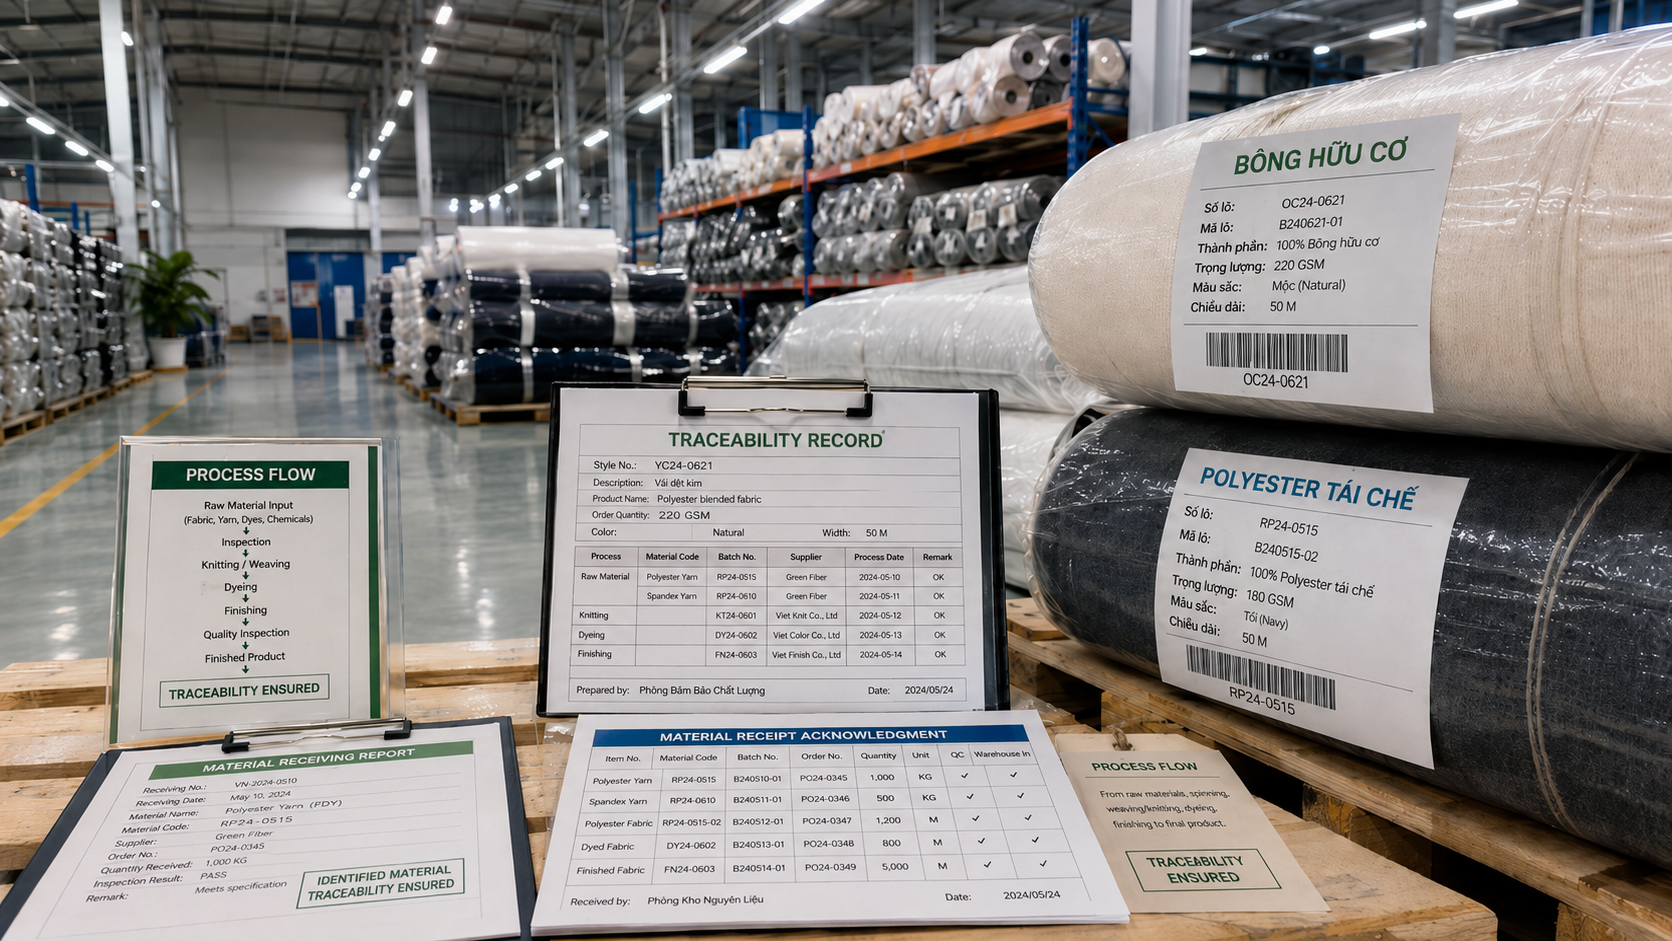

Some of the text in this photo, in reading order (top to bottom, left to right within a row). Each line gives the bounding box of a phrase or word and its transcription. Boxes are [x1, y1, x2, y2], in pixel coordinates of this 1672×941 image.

[1234, 136, 1409, 175] BÔNG HỮU CƠ
[1282, 195, 1344, 209] OC24-0621
[1279, 216, 1342, 230] B240621-01
[1277, 239, 1305, 250] 100%
[1195, 259, 1325, 275] Trọng 220 GSM
[1298, 279, 1346, 293] (Natural)
[1270, 301, 1296, 312] 50 M
[1243, 373, 1308, 389] OC24-0621
[668, 432, 882, 448] TRACEABILITY RECORD
[594, 460, 712, 471] Style No.: YC24-0621
[187, 468, 316, 481] PROCESS FLOW
[593, 478, 643, 488] Description:
[1200, 467, 1419, 511] POLYESTER TÁI CHẾ
[592, 494, 761, 505] Product Name: Polyester blended fabric
[204, 501, 293, 511] Raw Material Input
[184, 515, 313, 526] (Fabric, Dyes, Chemicals)
[592, 511, 710, 520] Order Quantity: 220 GSM
[1184, 506, 1319, 536] Số RP24-0515
[591, 527, 617, 536] Color:
[713, 528, 744, 536] Natural
[822, 529, 850, 537] Width:
[866, 529, 877, 537] 50
[222, 537, 271, 548] Inspection
[591, 552, 621, 560] Process
[790, 553, 822, 562] Supplier
[854, 553, 885, 561] Process
[923, 553, 952, 561] Remark
[1255, 541, 1318, 563] B240515-02
[202, 559, 290, 571] Knitting Weaving
[647, 573, 680, 582] Polyester
[786, 573, 808, 581] Green
[1251, 566, 1332, 591] 100% Polyester
[225, 582, 257, 593] Dyeing
[1172, 574, 1294, 608] Trọng 180 GSM
[647, 592, 678, 601] Spandex
[225, 606, 267, 616] Finishing
[579, 611, 608, 621] Knitting
[1259, 614, 1288, 631] (Navy)
[204, 628, 290, 640] Quality Inspection
[579, 631, 605, 640] Dyeing
[860, 631, 902, 639] 2024-05-13
[1242, 632, 1267, 647] 50 M
[205, 652, 285, 663] Finished Product
[578, 650, 612, 659] Finishing
[169, 683, 320, 700] TRACEABILITY ENSURED
[577, 686, 629, 696] Prepared by:
[905, 686, 953, 694] 2024/05/24
[1230, 686, 1295, 715] RP24-0515
[660, 730, 947, 741] MATERIAL RECEIPT ACKNOWLEDGMENT
[203, 748, 415, 772] MATERIAL RECEIVING REPORT
[1092, 762, 1197, 771] PROCESS FLOW
[593, 778, 631, 786] Polyester
[143, 786, 186, 794] Receiving
[589, 798, 626, 807] Spandex
[121, 823, 190, 833] Material Code:
[115, 839, 157, 848] Supplier:
[581, 843, 605, 852] Dyed
[617, 866, 645, 874] Fabric
[1146, 856, 1243, 883] TRACEABILITY ENSURED
[93, 871, 227, 889] Inspection Result: PASS
[317, 865, 451, 886] IDENTIFIED MATERIAL
[86, 882, 287, 902] Remark: Meets specification
[308, 879, 454, 901] TRACEABILITY ENSURED
[571, 896, 701, 907] Received by: Kho
[945, 893, 971, 901] Date:
